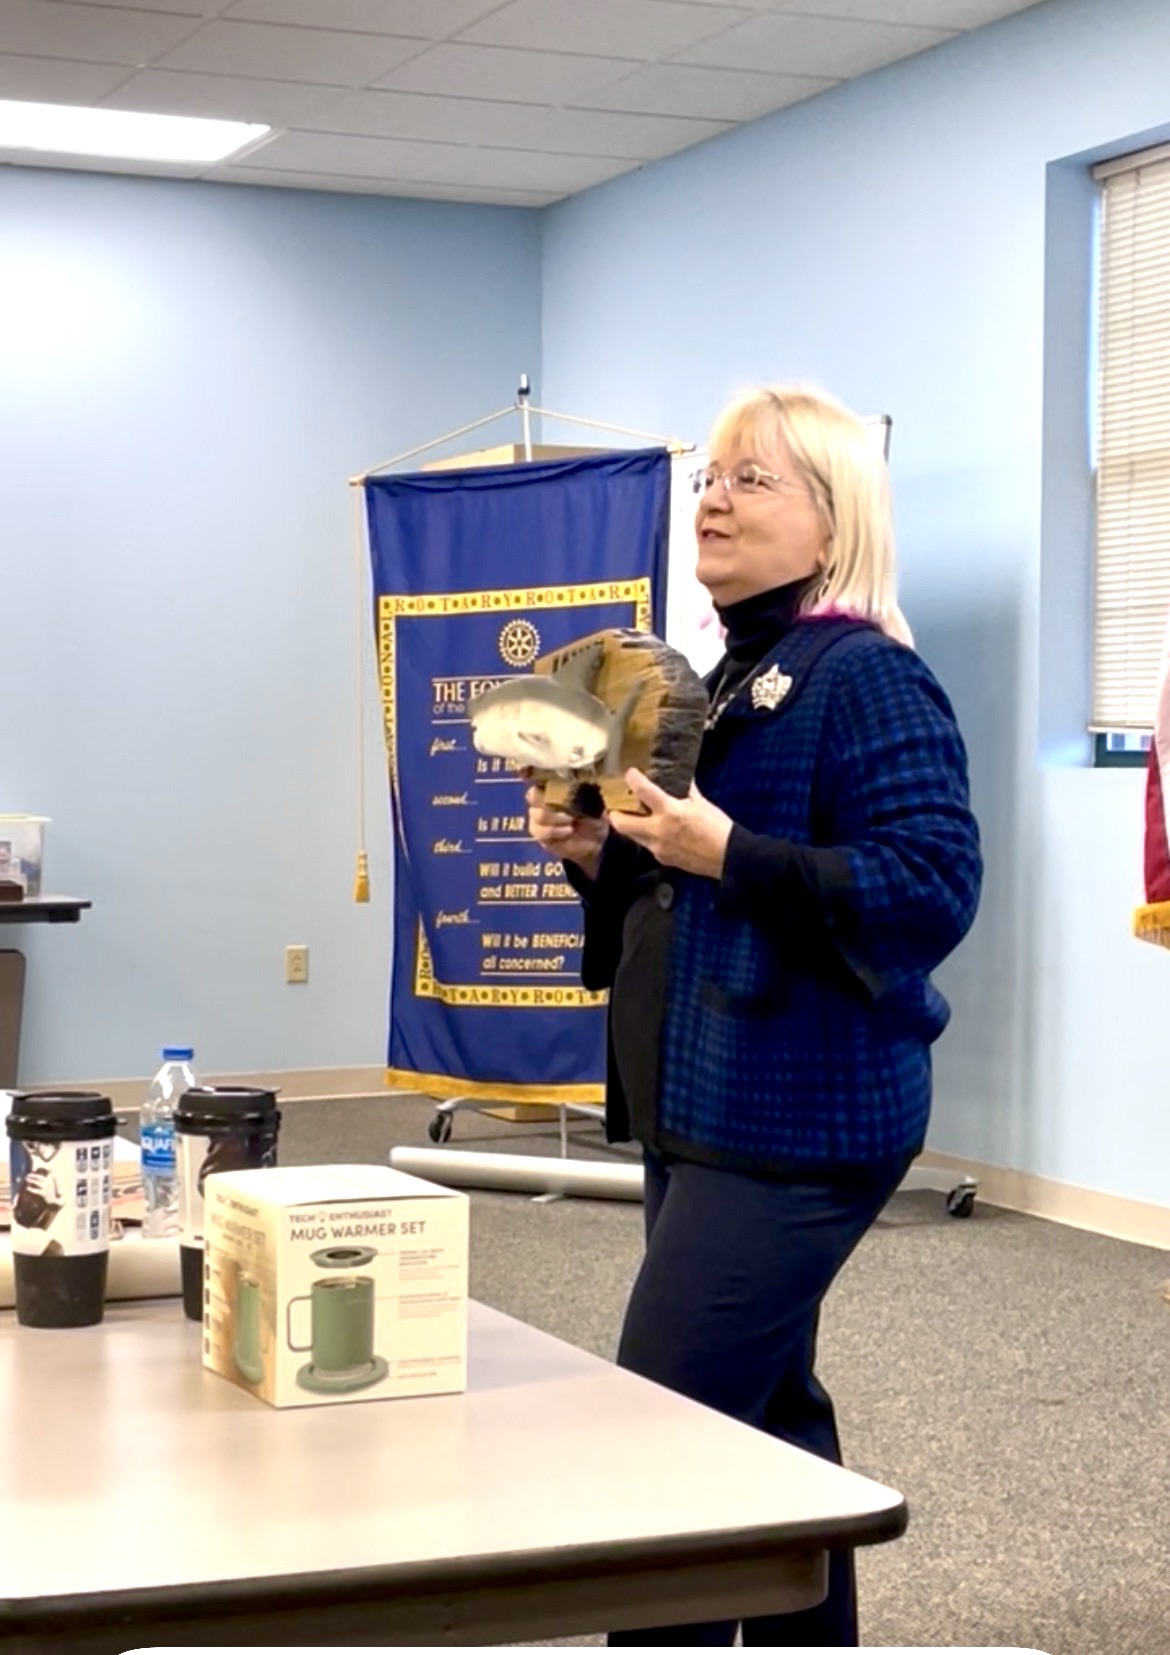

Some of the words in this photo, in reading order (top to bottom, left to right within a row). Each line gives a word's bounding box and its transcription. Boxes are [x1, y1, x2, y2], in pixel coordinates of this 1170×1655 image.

[433, 681, 465, 702] THE
[447, 702, 466, 714] the
[477, 758, 488, 773] Is
[491, 757, 501, 772] it
[478, 816, 488, 832] Is
[490, 816, 500, 832] it
[502, 816, 526, 832] FAIR
[479, 862, 501, 877] Will
[502, 862, 511, 877] it
[512, 861, 541, 877] build
[480, 884, 501, 899] and
[504, 883, 539, 898] BETTER
[481, 933, 502, 948] Will
[503, 933, 511, 948] it
[513, 933, 529, 949] be
[482, 955, 497, 970] all
[499, 955, 565, 970] concerned?
[289, 1213, 316, 1223] TECH
[329, 1209, 393, 1221] ENTHUSIAST
[290, 1226, 328, 1242] MUG
[331, 1222, 397, 1239] WARMER
[400, 1220, 427, 1236] SET
